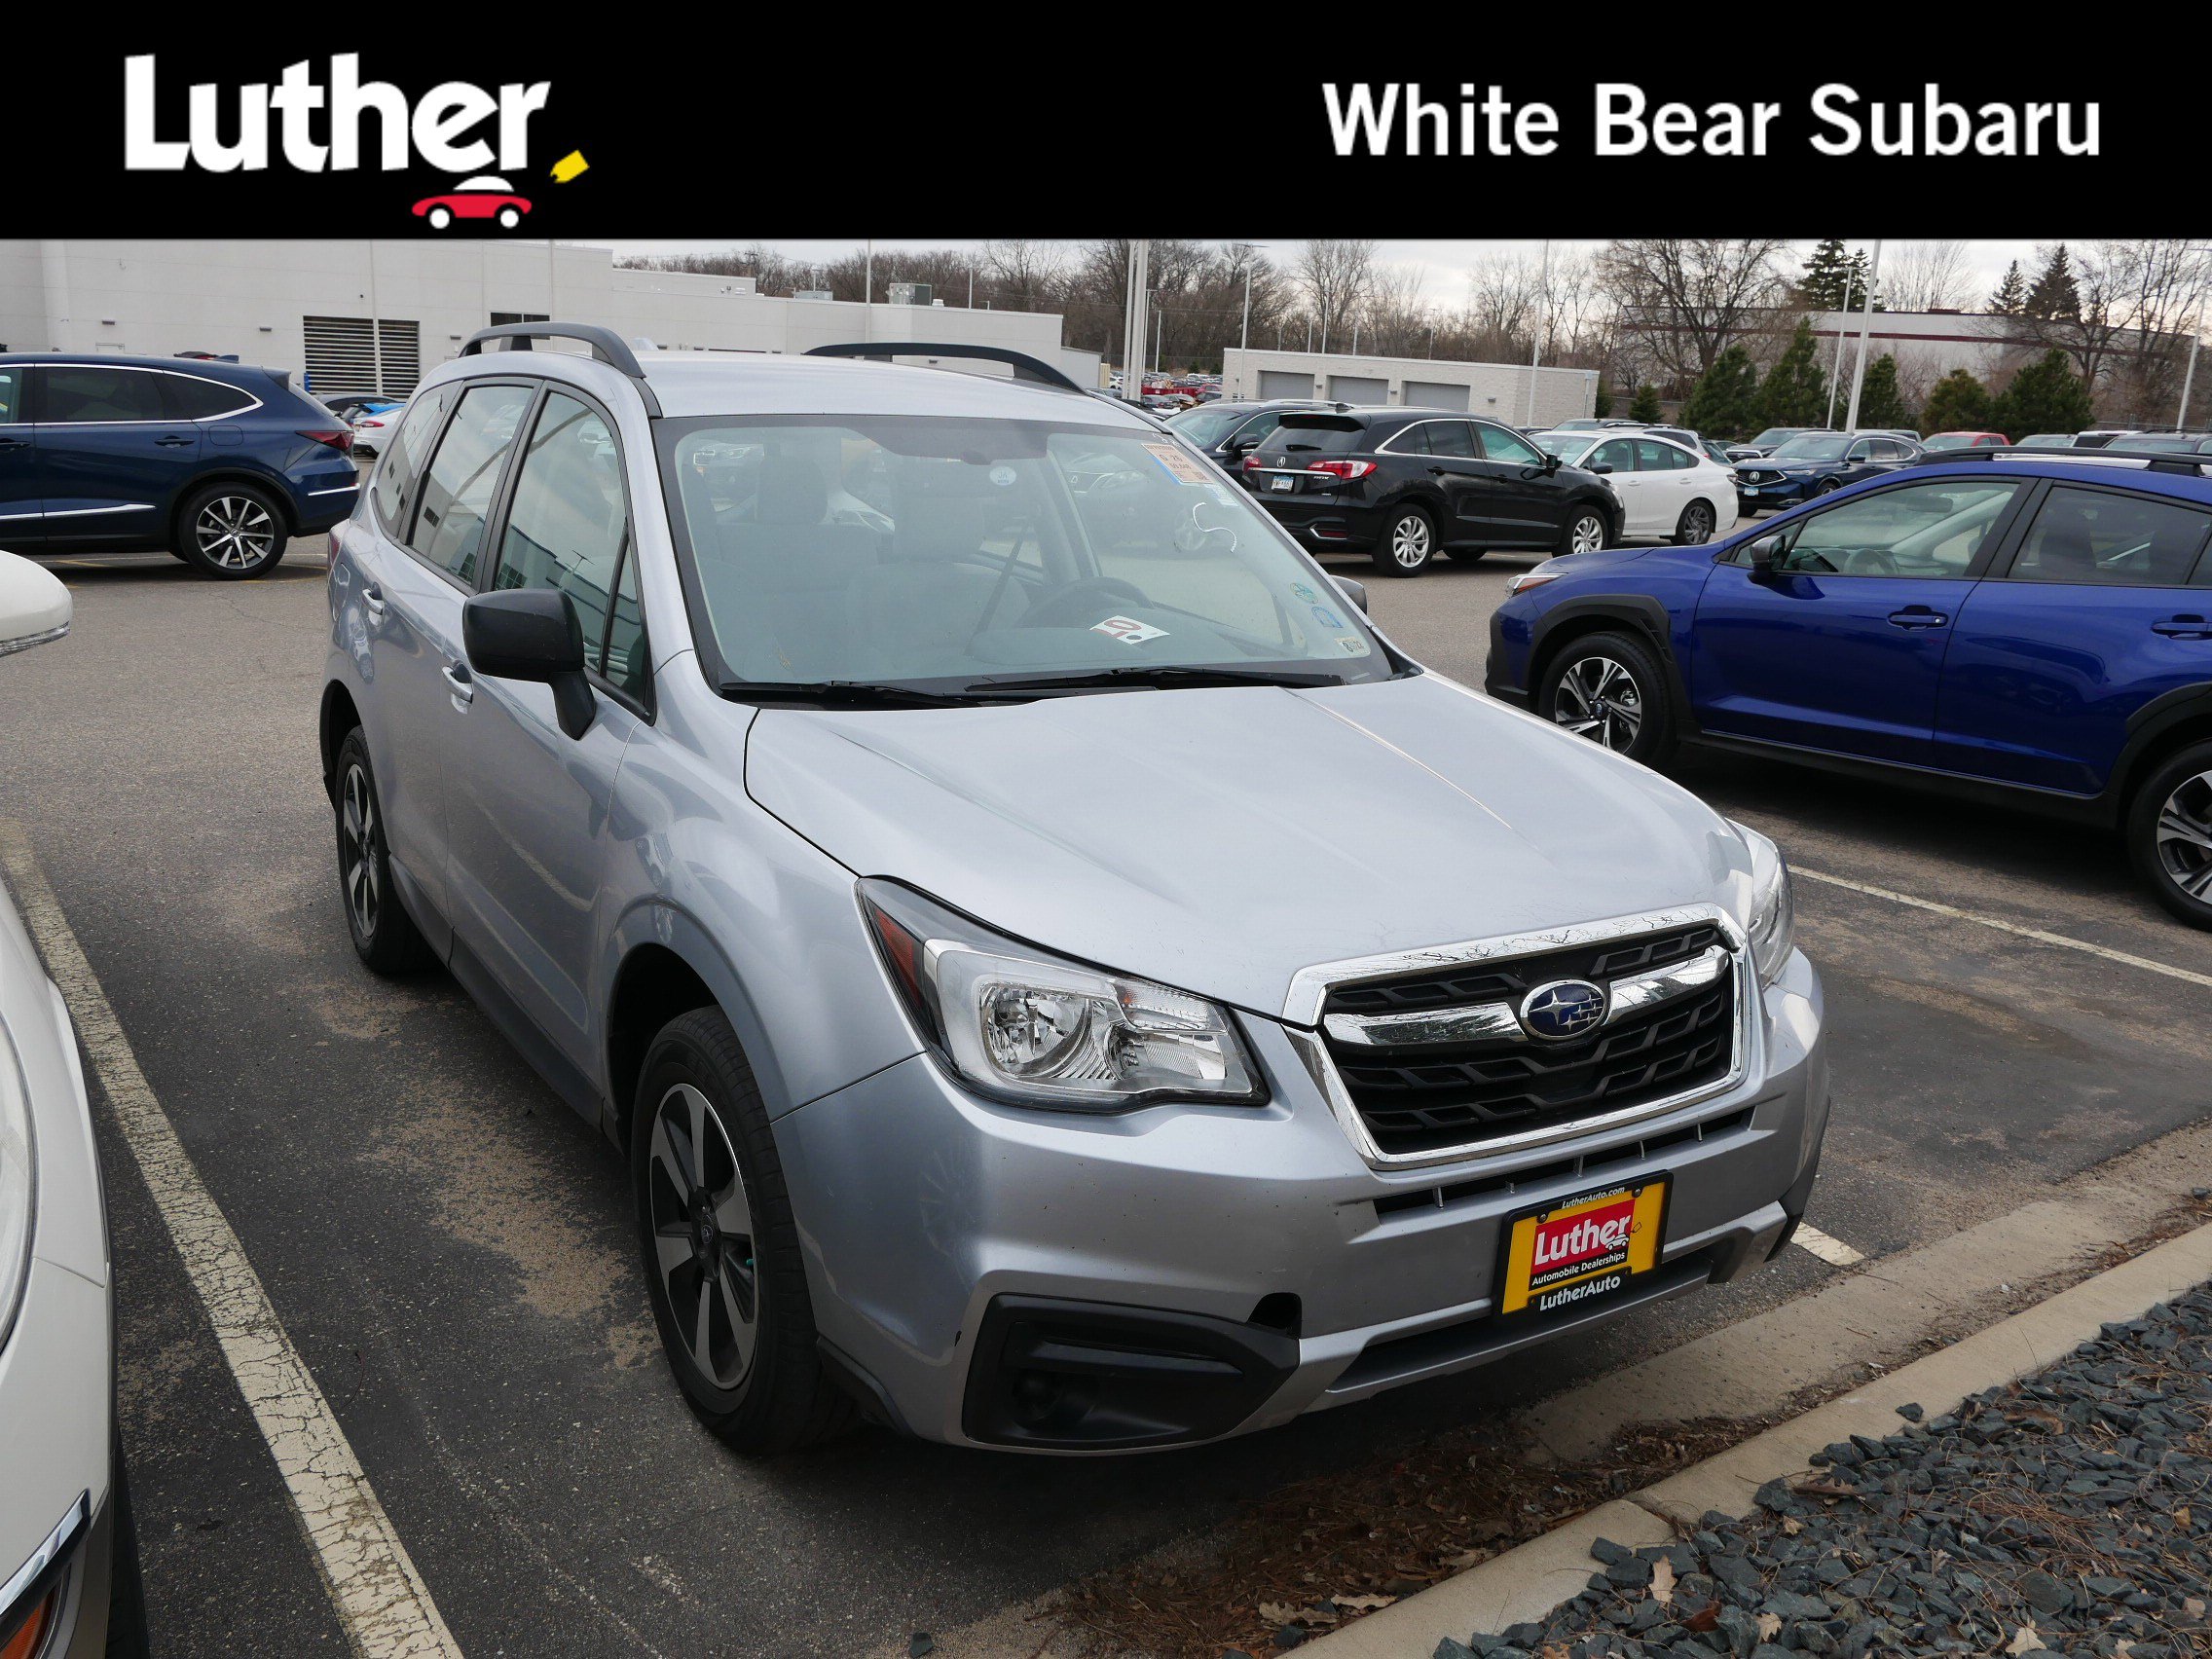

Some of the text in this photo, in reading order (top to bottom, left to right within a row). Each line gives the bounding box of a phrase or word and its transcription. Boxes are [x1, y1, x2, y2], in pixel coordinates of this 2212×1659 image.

[1561, 1186, 1625, 1209] LutherAuto.com
[1534, 1215, 1632, 1266] Luther
[1531, 1251, 1626, 1286] Automobile Dealerships
[1539, 1275, 1621, 1311] LutherAuto
